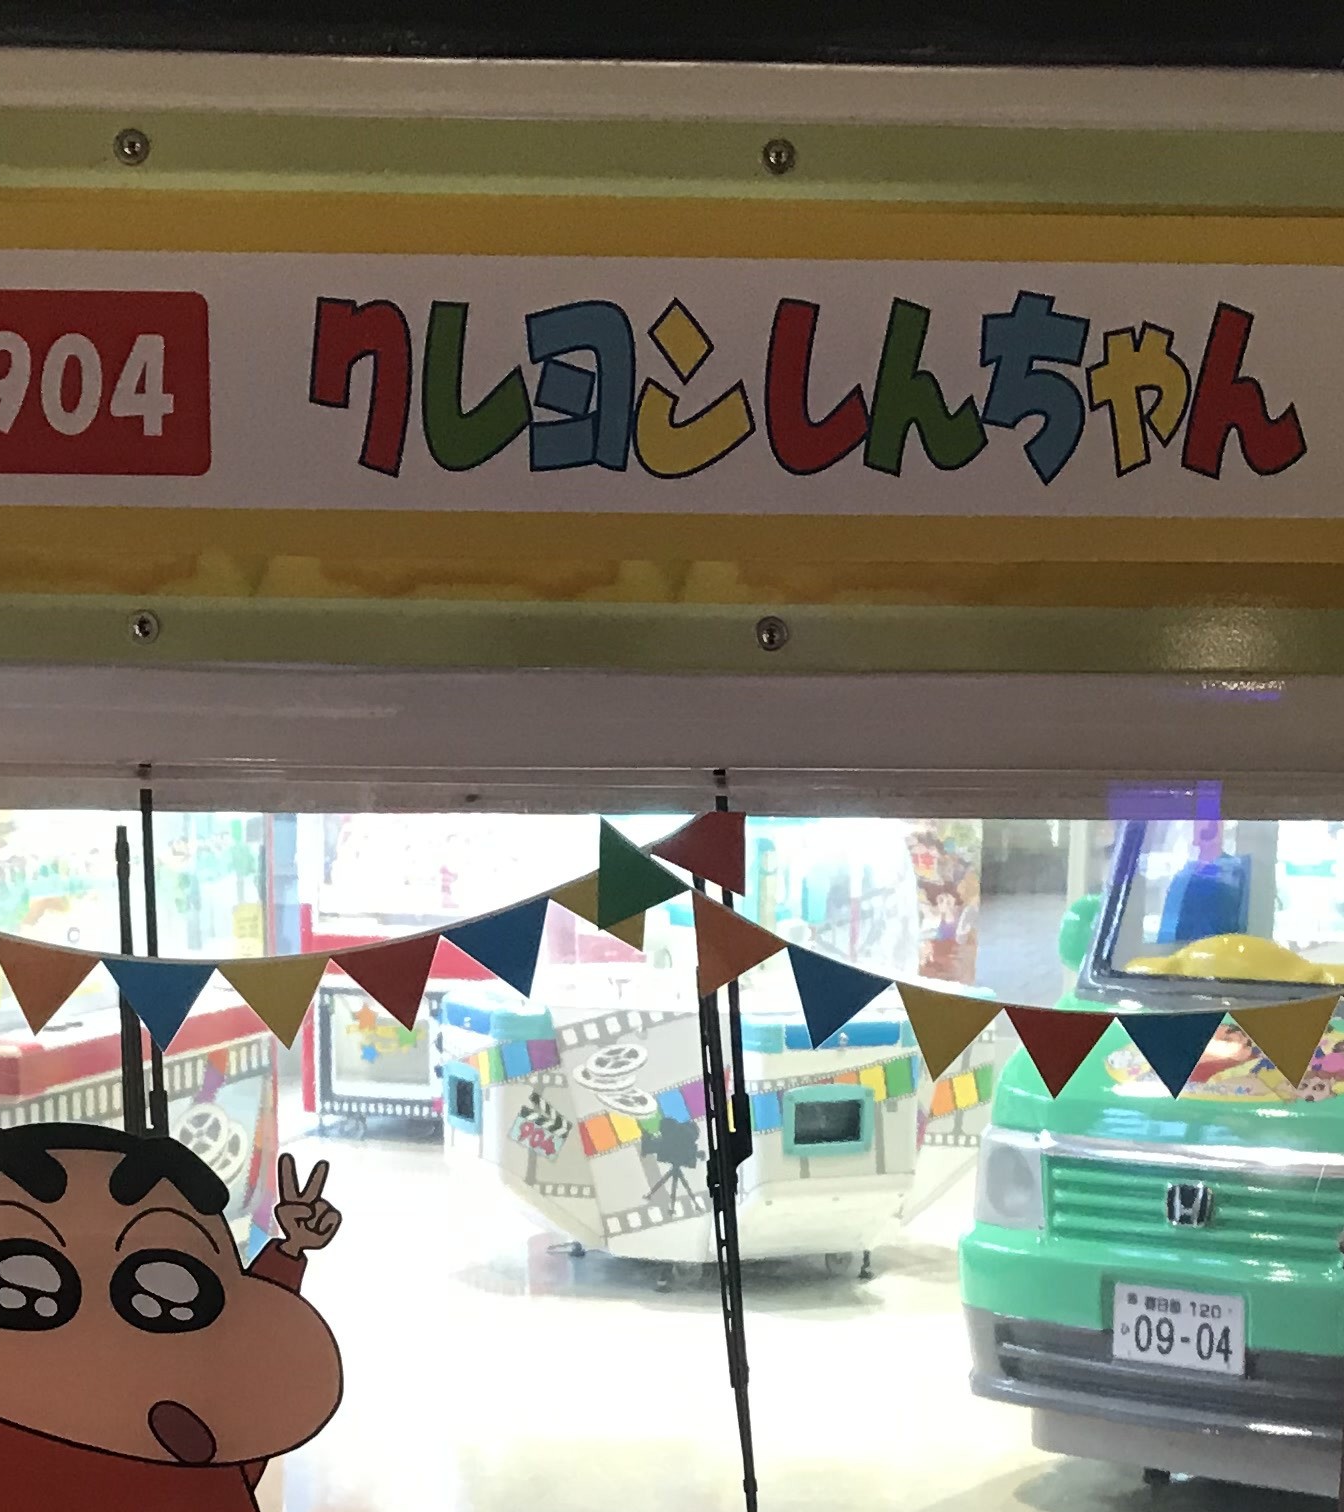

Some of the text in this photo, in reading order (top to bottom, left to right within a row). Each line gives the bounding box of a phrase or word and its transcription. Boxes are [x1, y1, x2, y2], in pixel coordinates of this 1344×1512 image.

[308, 290, 1307, 485] クレヨンしんちゃん
[1190, 1302, 1221, 1318] 120
[1135, 1314, 1232, 1362] 09-04
